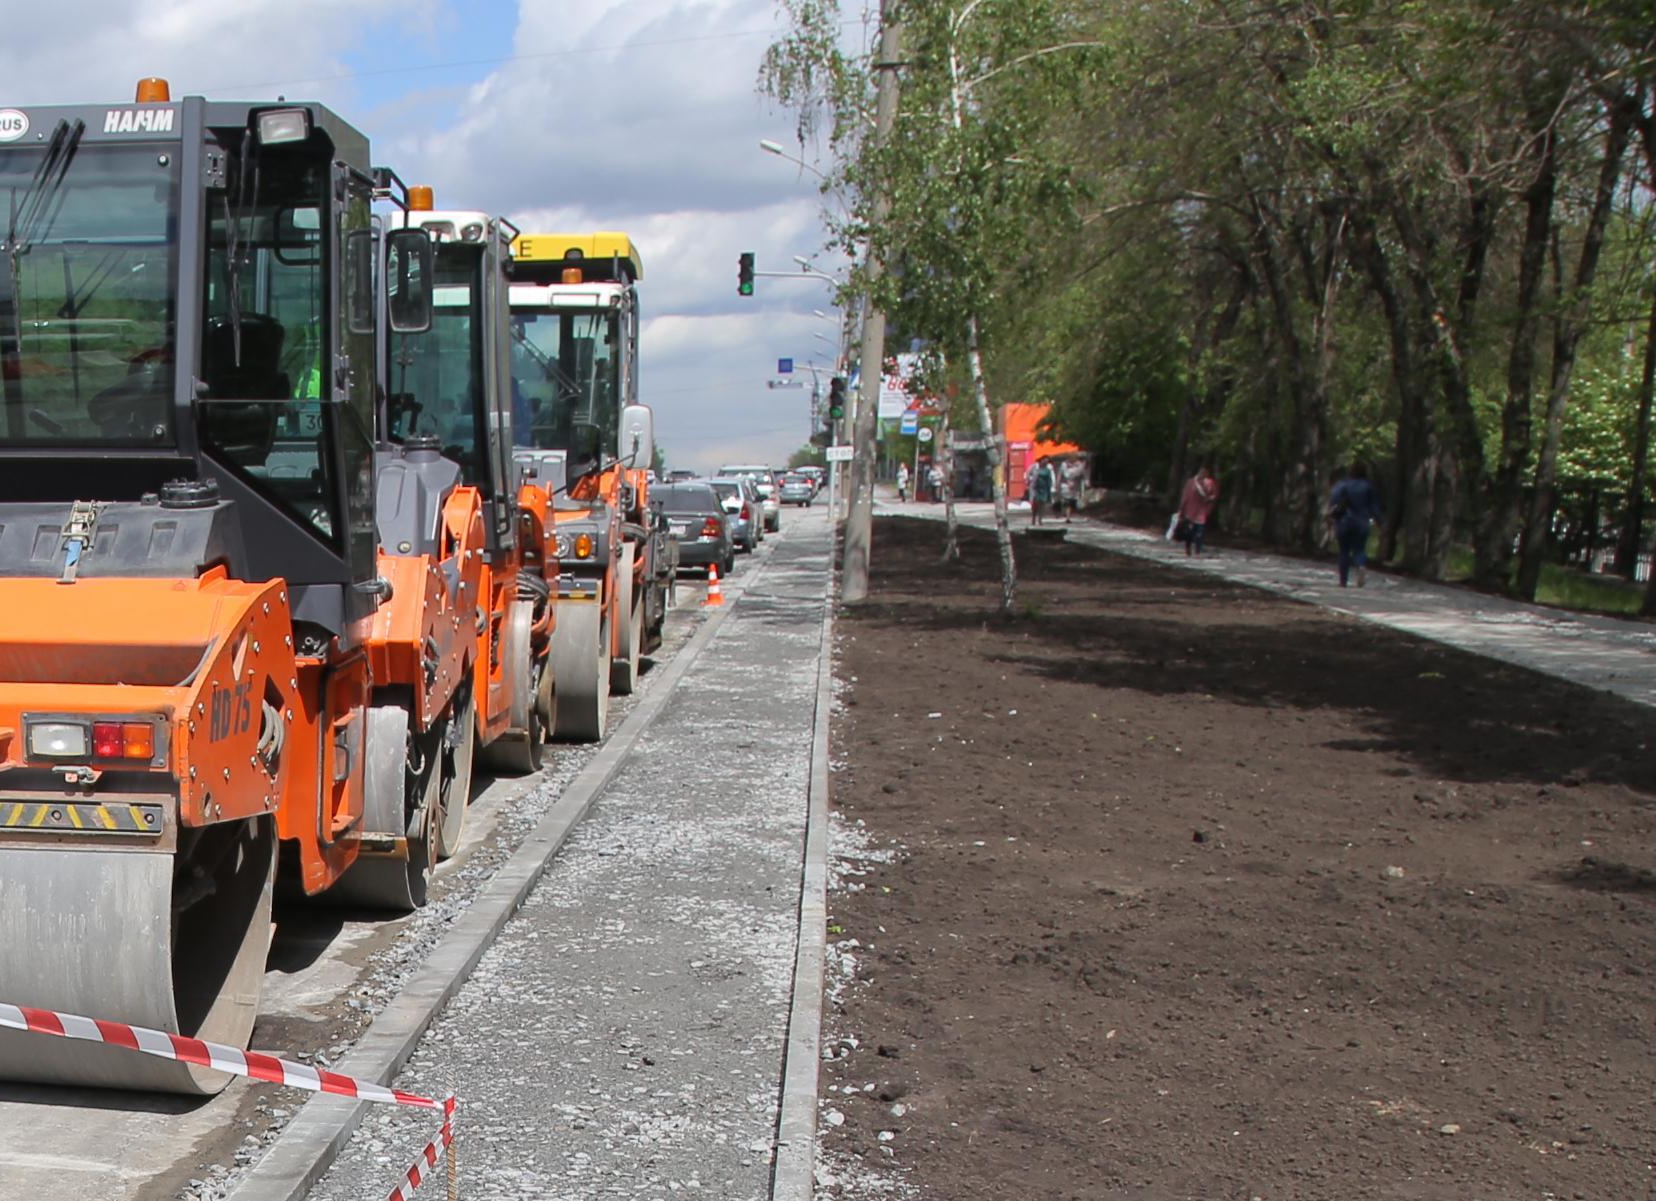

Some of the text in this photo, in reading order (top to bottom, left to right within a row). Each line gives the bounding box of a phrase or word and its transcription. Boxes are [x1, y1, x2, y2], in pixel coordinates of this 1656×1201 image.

[103, 109, 174, 133] HAMM
[519, 239, 533, 258] E
[209, 682, 252, 744] HD 75
